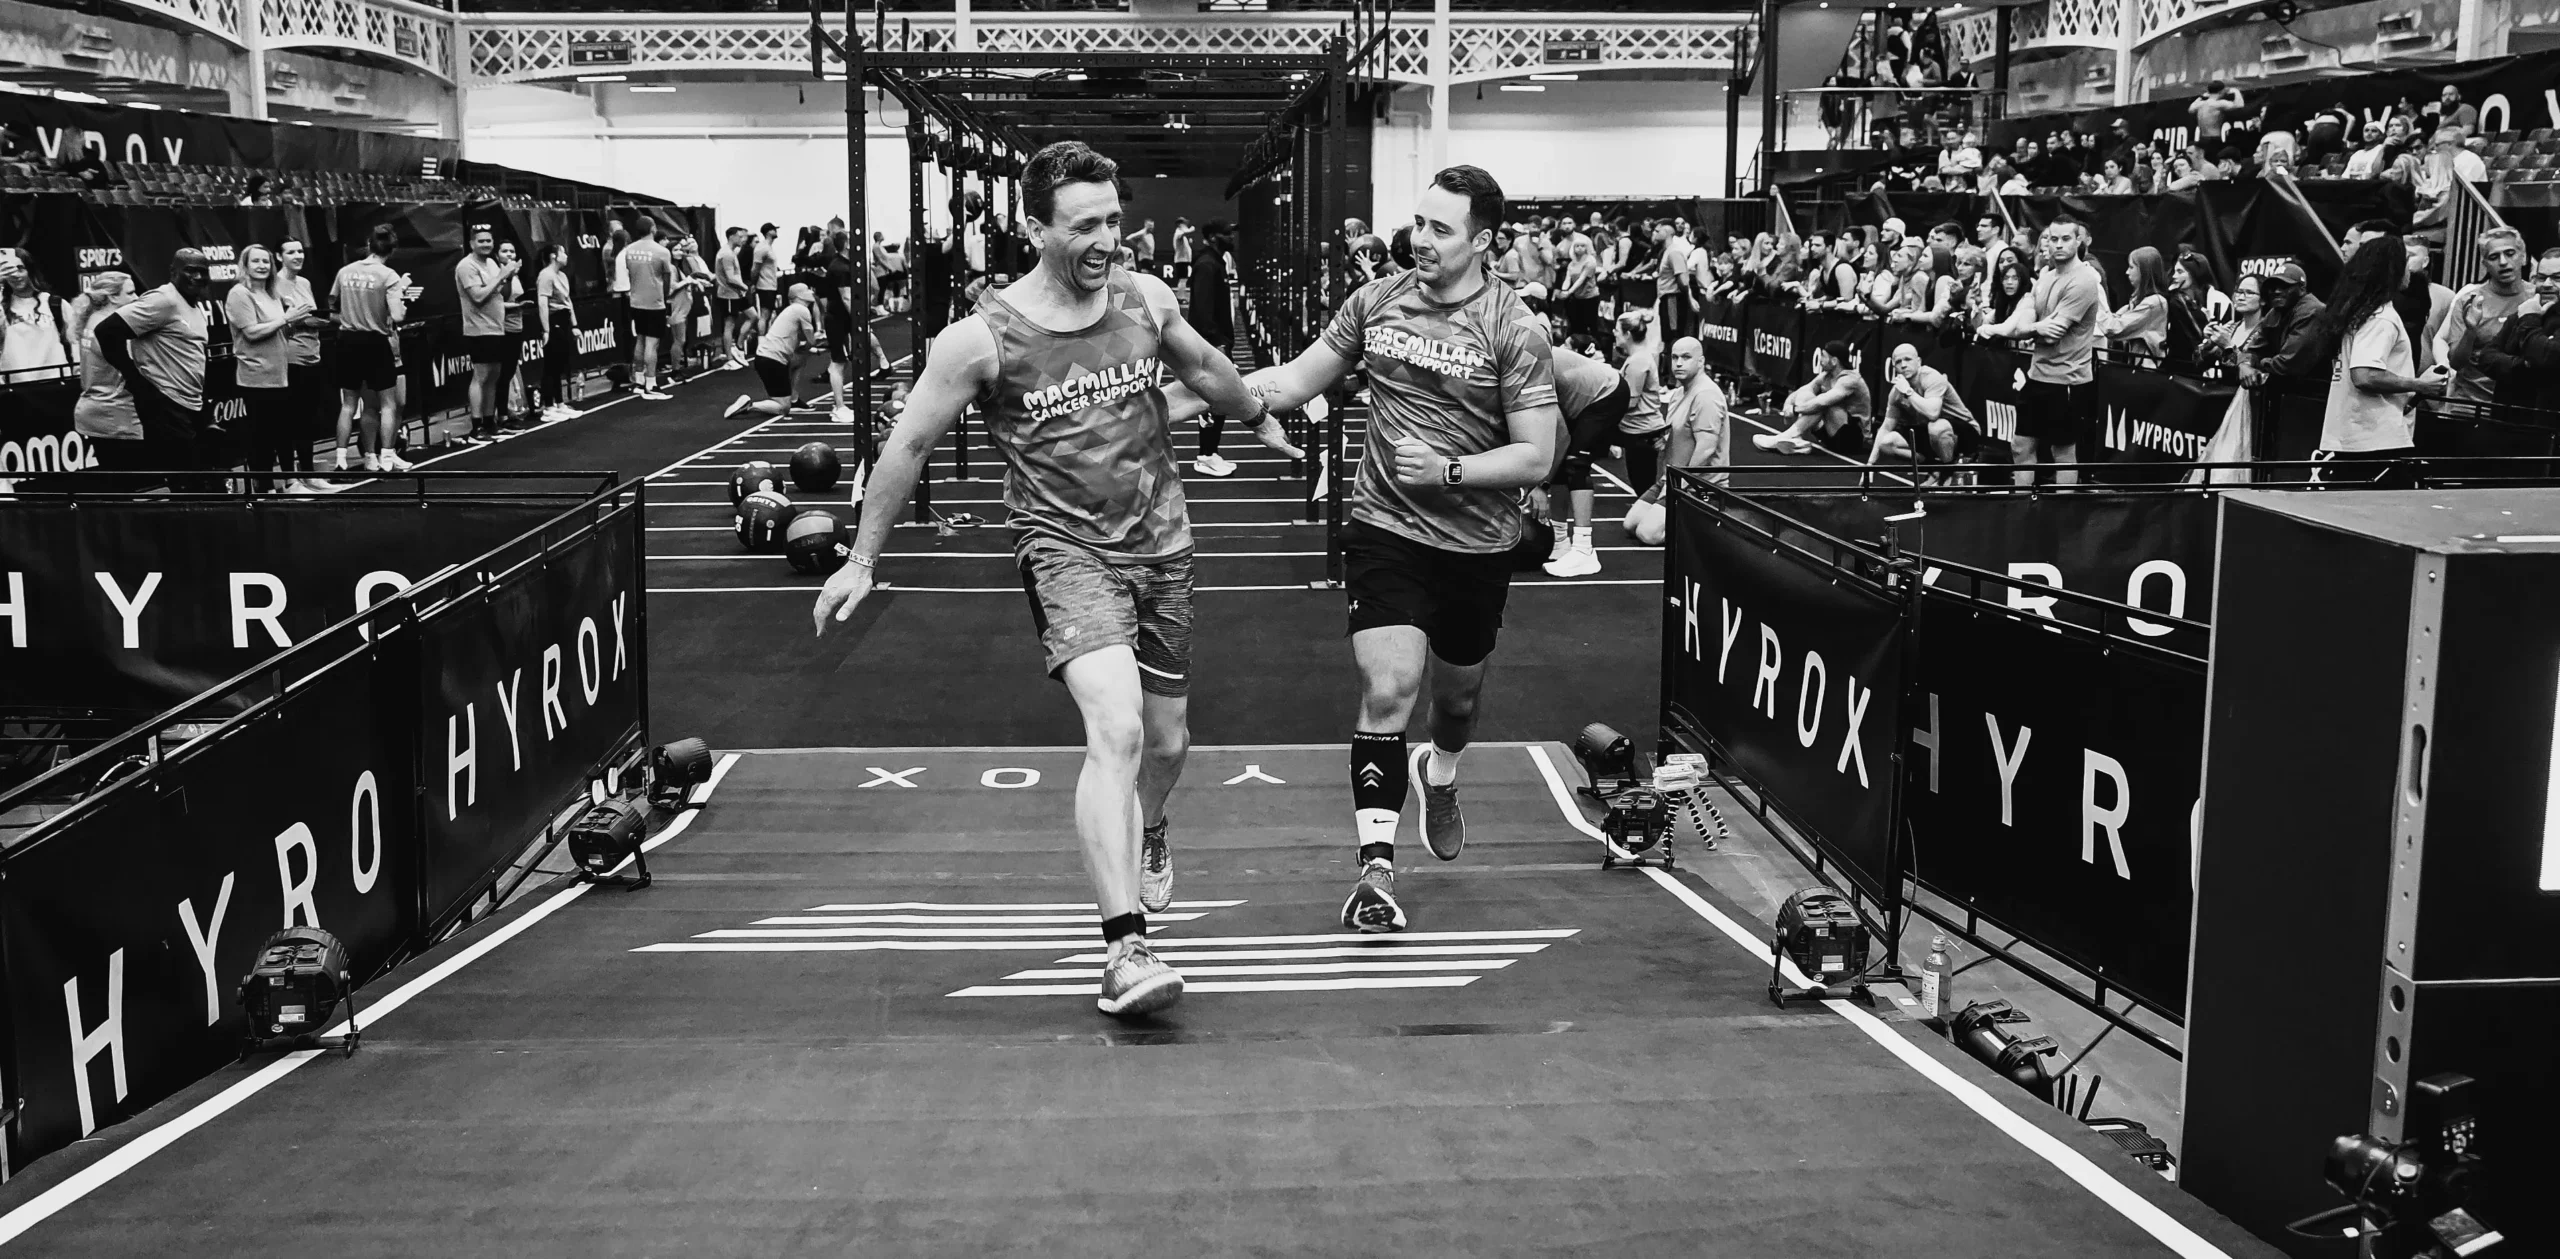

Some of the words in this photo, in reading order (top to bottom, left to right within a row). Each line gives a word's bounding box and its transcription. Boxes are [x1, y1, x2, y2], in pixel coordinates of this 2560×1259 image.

[1364, 326, 1485, 367] MACMILLAN
[1408, 352, 1474, 380] SUPPORT
[1022, 357, 1155, 411] MACMILLAN
[1031, 391, 1091, 422] CANCER
[1092, 375, 1153, 405] SUPPORT
[2132, 419, 2206, 459] MYPROTE
[447, 591, 626, 820] HYROX
[1685, 575, 1871, 789] HYROX
[1912, 692, 2131, 880] HYR
[64, 770, 381, 1138] HYRO
